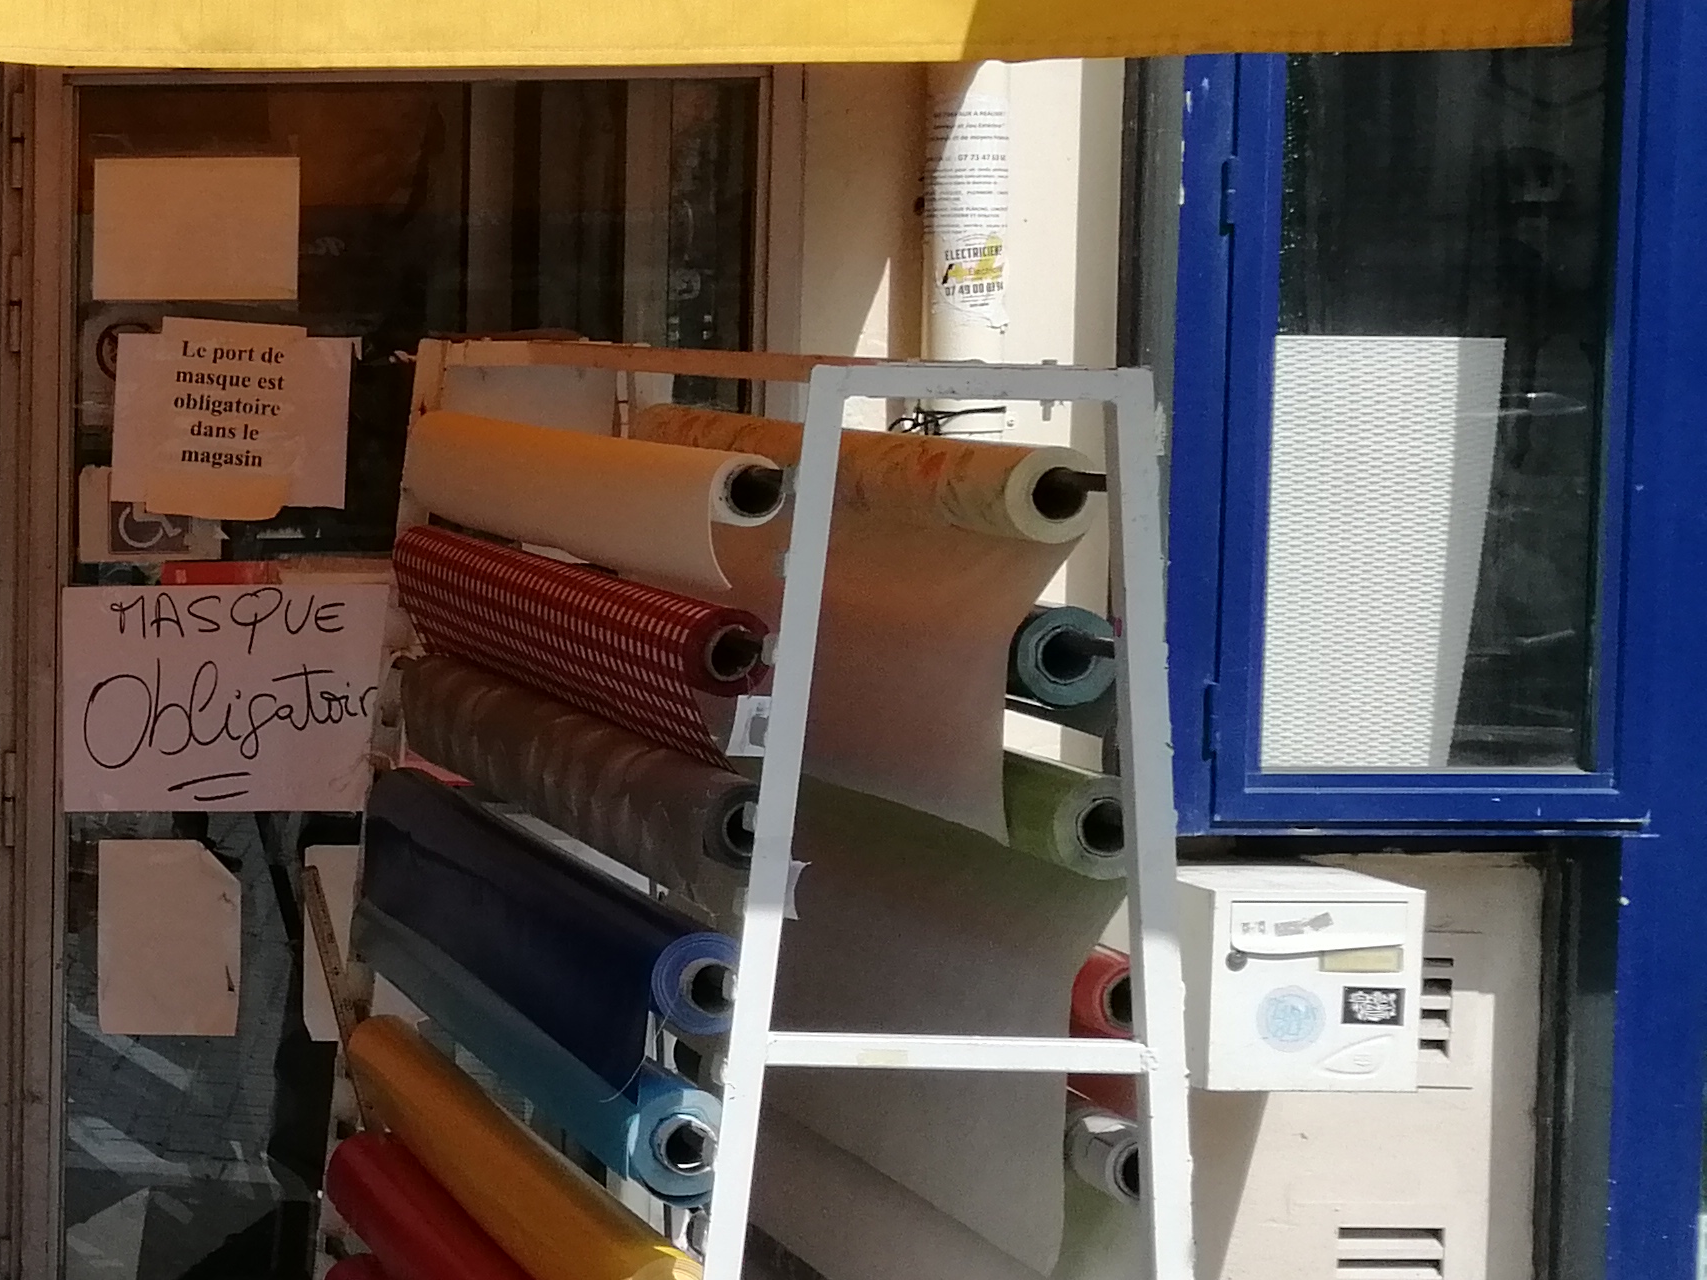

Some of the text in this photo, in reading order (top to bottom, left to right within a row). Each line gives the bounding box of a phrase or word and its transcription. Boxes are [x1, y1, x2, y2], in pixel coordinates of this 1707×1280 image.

[181, 340, 285, 364] Le port de
[175, 370, 285, 391] masque est
[173, 393, 281, 417] obligatoire
[190, 420, 259, 441] dans le
[180, 449, 262, 469] magasin
[110, 587, 346, 655] MASQUE
[83, 657, 379, 769] Obligatoir
